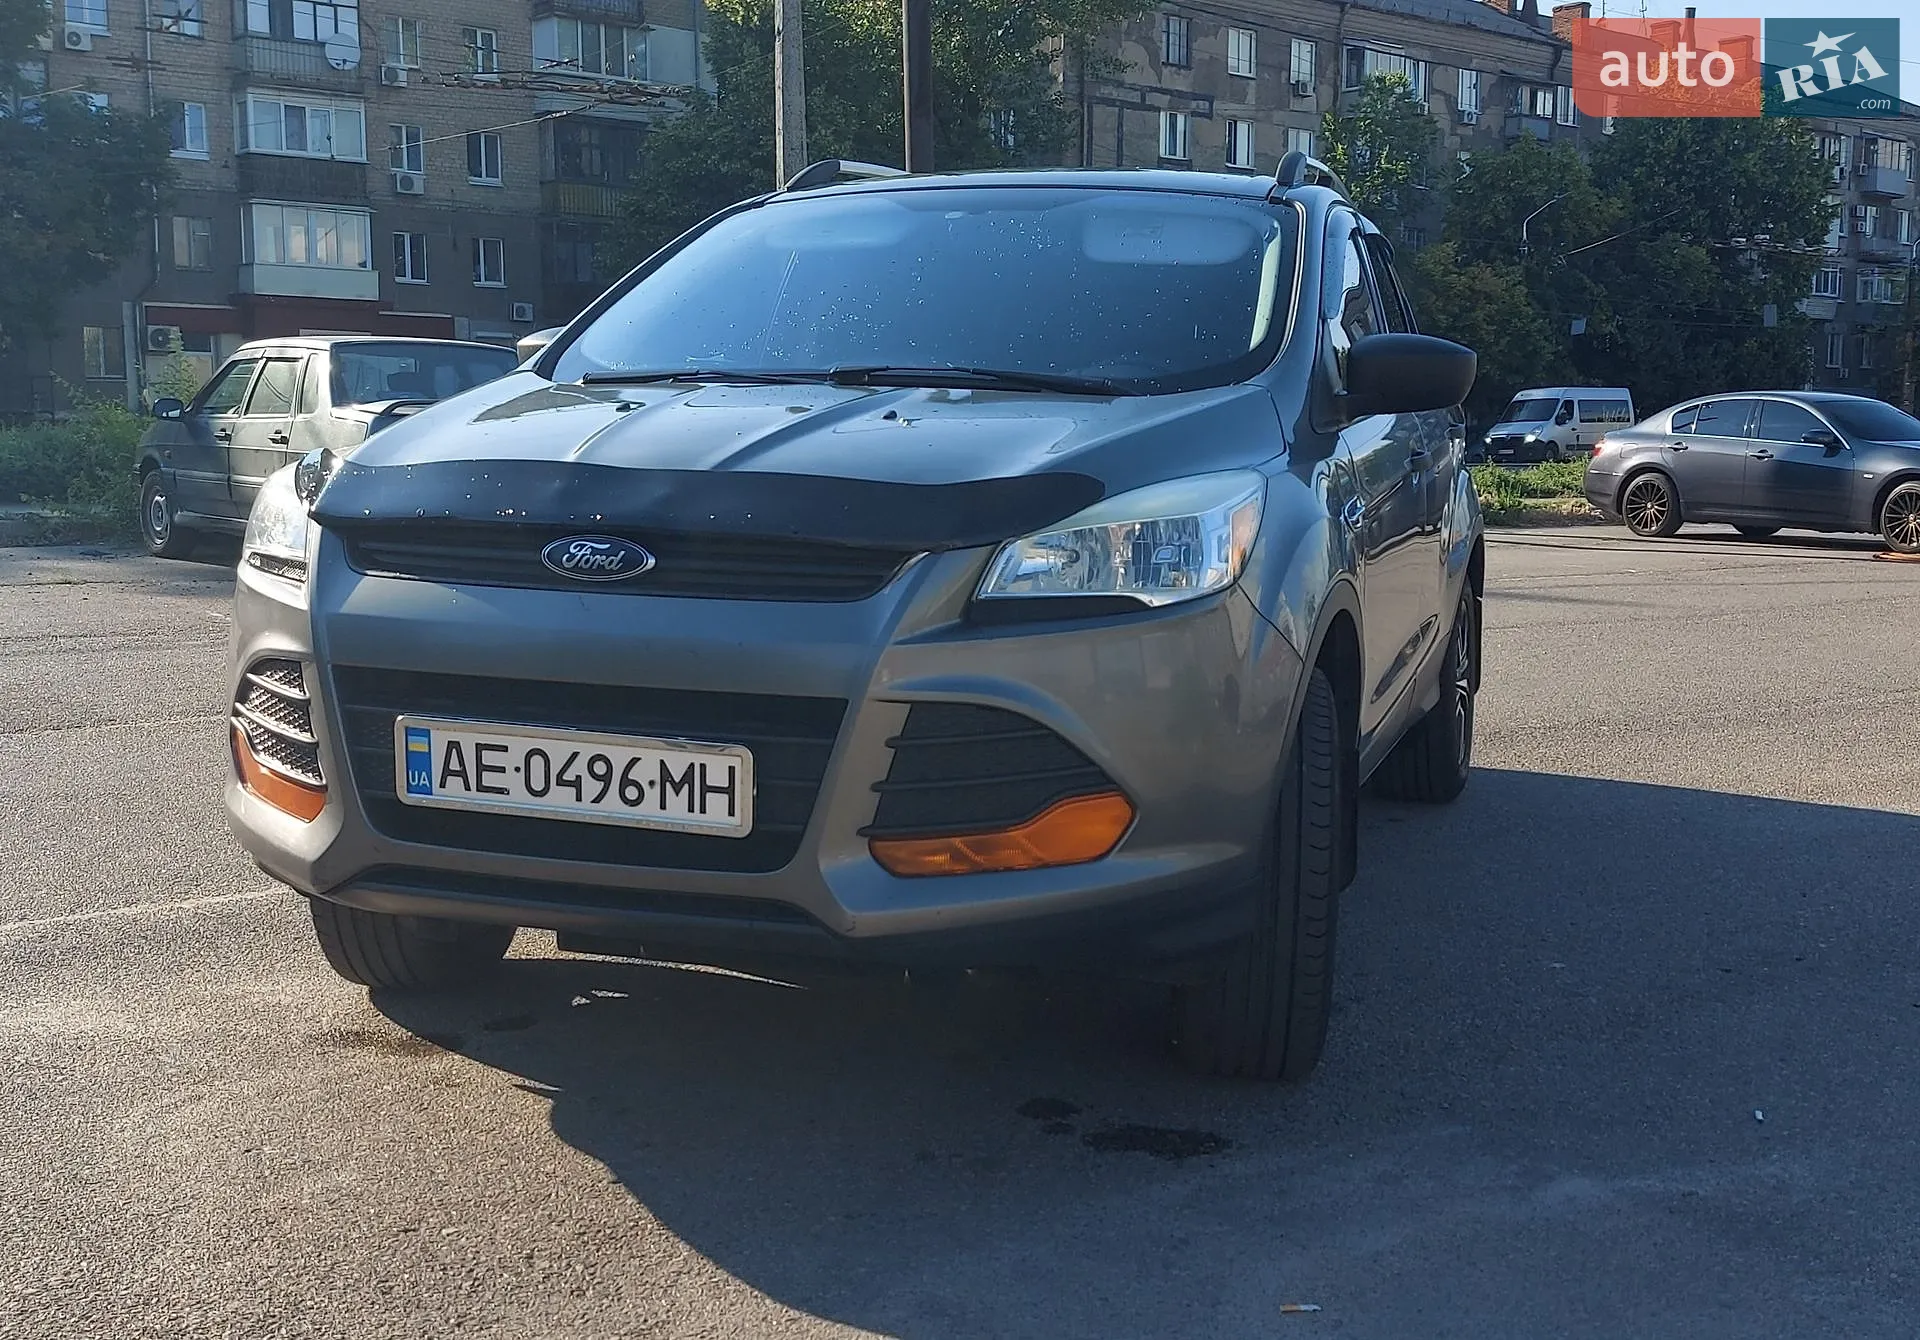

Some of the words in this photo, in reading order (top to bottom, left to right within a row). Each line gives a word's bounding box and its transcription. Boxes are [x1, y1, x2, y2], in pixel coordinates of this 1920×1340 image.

[561, 540, 624, 570] Ford
[408, 770, 430, 788] UA
[438, 740, 510, 796] AE
[523, 747, 646, 807] 0496
[658, 758, 736, 817] MH
